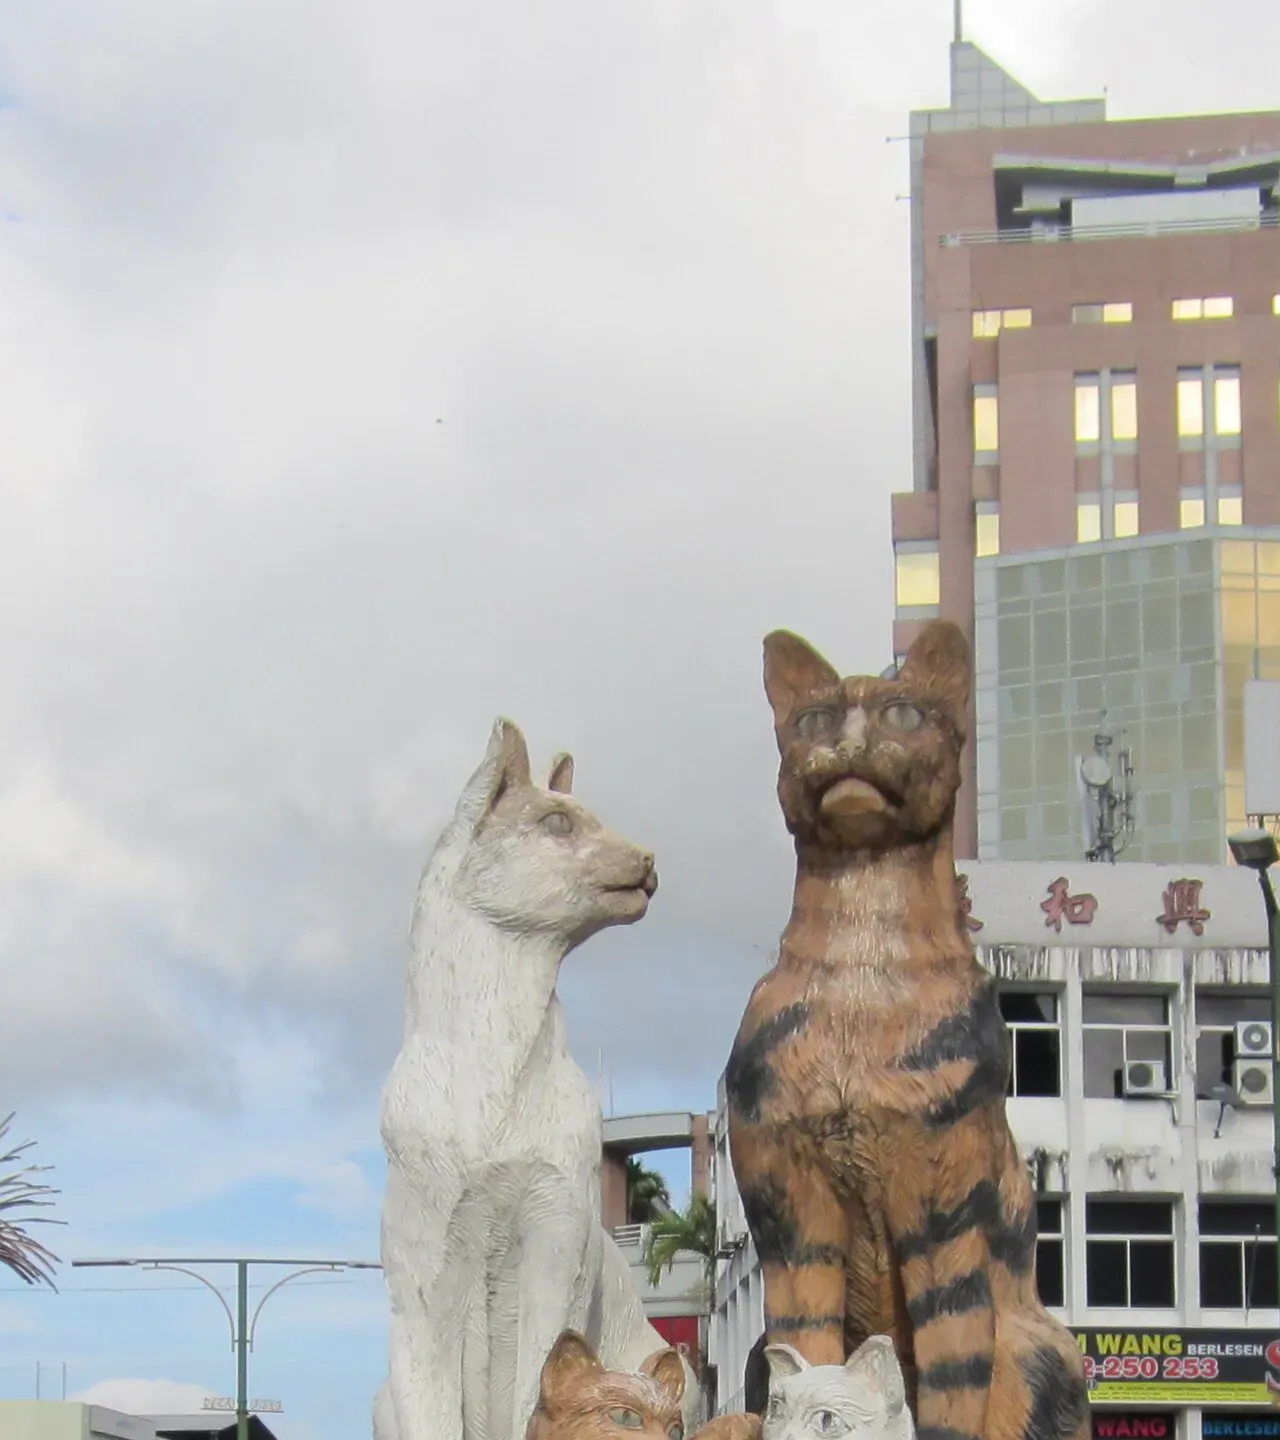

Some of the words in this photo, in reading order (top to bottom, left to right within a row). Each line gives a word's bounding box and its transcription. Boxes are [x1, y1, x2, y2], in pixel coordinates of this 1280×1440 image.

[1095, 1333, 1183, 1355] WANG
[1187, 1344, 1263, 1356] BERLESEN
[1163, 1356, 1219, 1379] 253
[1098, 1419, 1167, 1437] WANG
